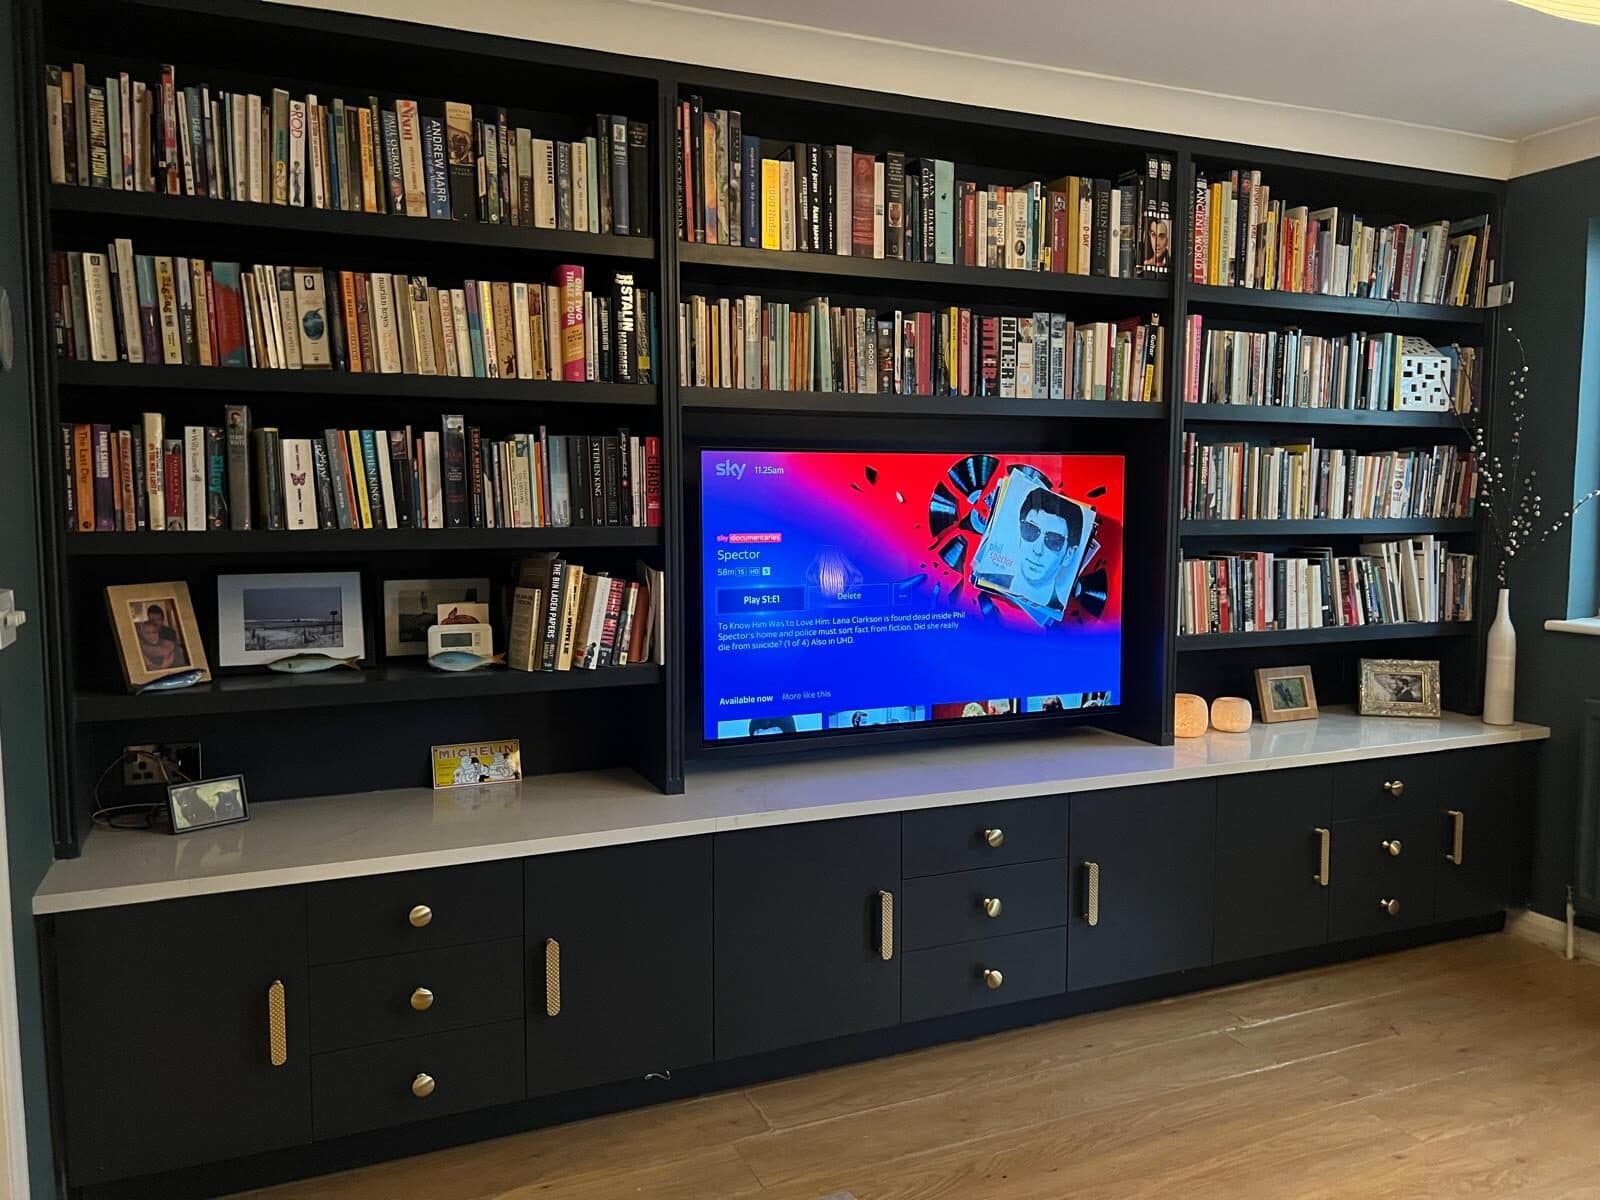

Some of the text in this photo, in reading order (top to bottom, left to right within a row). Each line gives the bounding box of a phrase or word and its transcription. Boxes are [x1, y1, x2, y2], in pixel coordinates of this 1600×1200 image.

[90, 100, 108, 177] IMMEDIATE ACTION
[192, 118, 202, 144] DEAD
[291, 111, 303, 139] ROD
[387, 115, 396, 137] PAUL
[401, 103, 414, 141] Nixon
[431, 120, 446, 201] ANDREW MARR
[1101, 192, 1109, 228] BERLIN
[1194, 189, 1205, 269] ANCIENT WORLD
[161, 275, 174, 313] ZigZag
[379, 277, 389, 328] marian keyes
[620, 286, 634, 332] STALIN
[567, 300, 575, 326] FOUR
[617, 332, 628, 376] HANGMEN
[982, 319, 997, 378] HITLER
[1002, 320, 1015, 379] HITLER
[79, 432, 89, 484] The Last Day
[364, 433, 380, 501] STEPHEN KING
[592, 442, 601, 476] STEPHEN
[648, 456, 659, 494] CHAOS
[715, 459, 746, 480] sky
[730, 533, 780, 542] documentaries
[717, 550, 760, 562] Spector
[717, 568, 735, 576] 58m
[547, 563, 561, 638] THE BIN LADEN PAPERS
[601, 580, 624, 647] GEORGE MELLY
[743, 595, 780, 605] Play S1:E1
[838, 592, 862, 600] Delete
[563, 617, 573, 654] WHITE LIE
[718, 632, 755, 642] Spector's
[756, 631, 778, 639] home
[794, 628, 817, 637] police
[818, 628, 837, 636] must
[854, 626, 868, 634] fact
[870, 625, 888, 633] from
[889, 624, 912, 632] fiction.
[940, 622, 959, 630] really
[719, 622, 728, 630] To
[730, 622, 750, 630] Know
[769, 620, 784, 628] Was
[796, 619, 814, 627] Love
[832, 617, 850, 625] Lana
[852, 616, 882, 624] Clarkson
[890, 614, 912, 622] found
[912, 613, 930, 621] dead
[932, 612, 952, 620] inside
[953, 611, 966, 619] Phil
[718, 643, 730, 651] die
[732, 642, 750, 650] from
[752, 640, 783, 649] suicide?
[810, 638, 826, 646] Also
[720, 696, 755, 706] Available
[782, 692, 802, 700] More
[816, 690, 832, 698] this
[438, 744, 514, 760] MICHELIN
